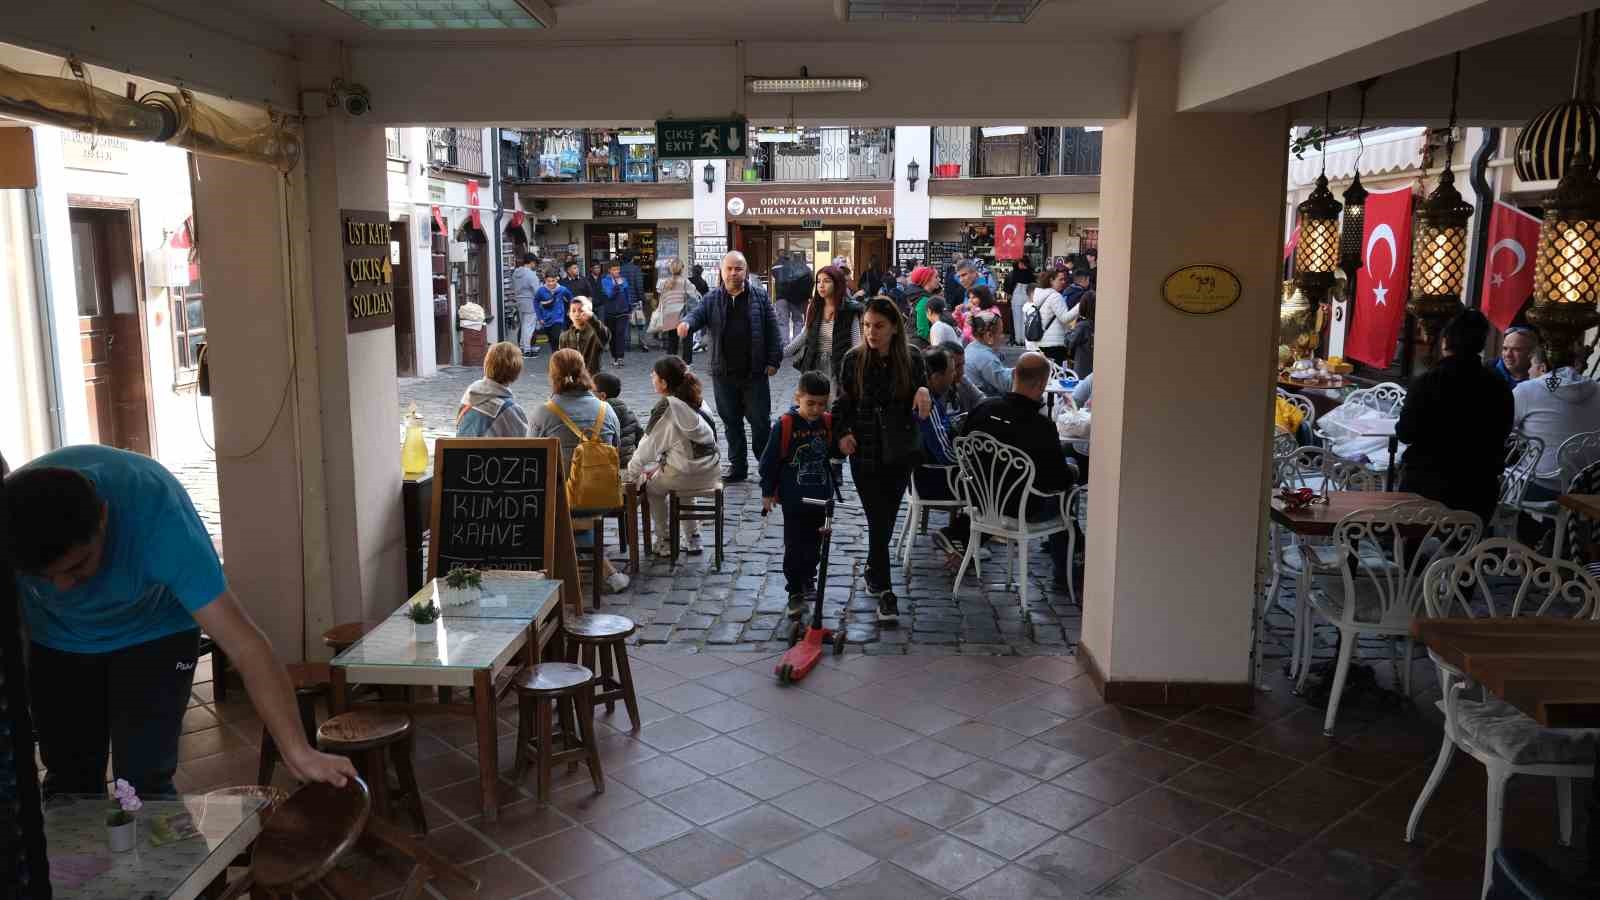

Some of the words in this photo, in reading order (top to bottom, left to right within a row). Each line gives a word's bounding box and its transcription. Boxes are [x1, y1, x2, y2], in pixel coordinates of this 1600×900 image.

[664, 128, 696, 141] ÇIKIŞ
[665, 141, 695, 152] EXIT
[746, 207, 786, 215] ATLIHAN
[787, 207, 799, 215] EL
[800, 207, 853, 215] SANATLARI
[854, 207, 892, 216] ÇARŞISI
[760, 197, 820, 206] ODUNPAZARI
[822, 195, 877, 205] BELEDİYESİ
[991, 196, 1028, 206] BAĞLAN
[347, 217, 366, 246] ÜST
[350, 258, 381, 288] ÇIKIŞ
[352, 291, 393, 318] SOLDAN
[461, 454, 539, 486] BOZA
[453, 494, 538, 520] KUMDA
[450, 522, 525, 546] KAHVE
